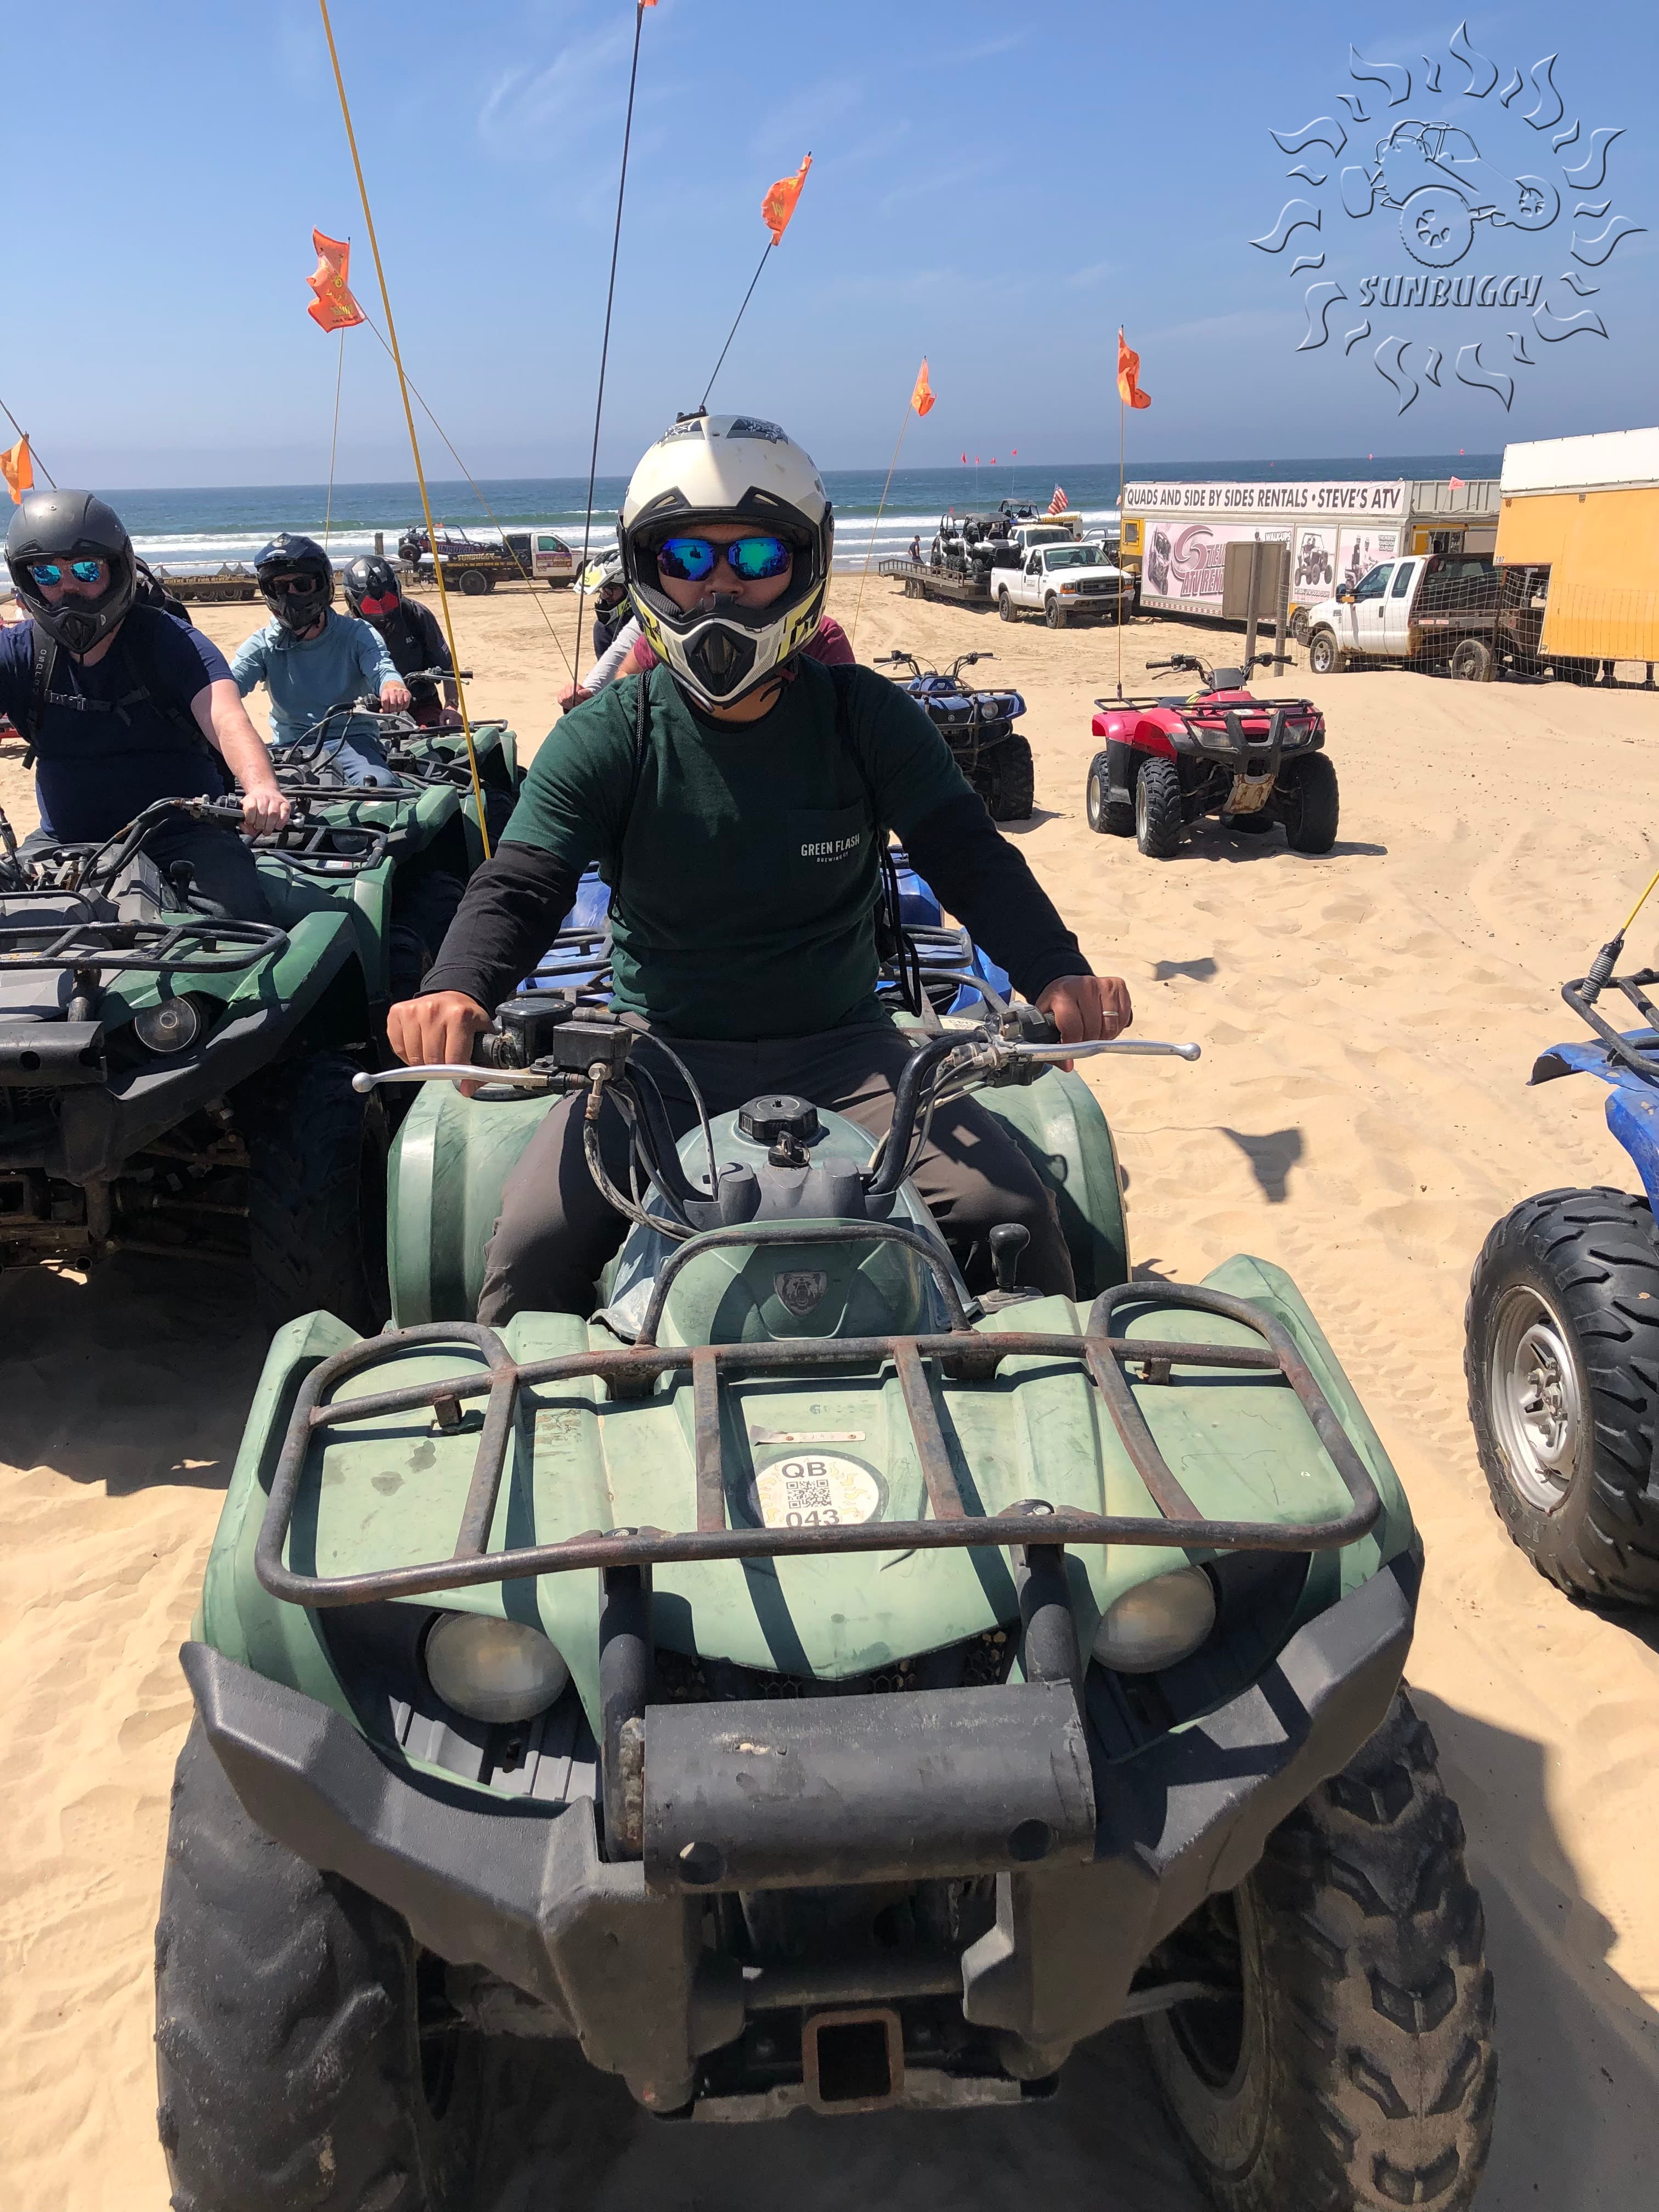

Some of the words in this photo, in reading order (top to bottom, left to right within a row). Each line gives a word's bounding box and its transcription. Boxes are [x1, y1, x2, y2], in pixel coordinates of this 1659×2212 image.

[1127, 488, 1158, 506] QUADS
[1160, 489, 1181, 506] AND
[1184, 489, 1206, 506] SIDE
[1209, 489, 1222, 506] BY
[1224, 489, 1254, 507] SIDES
[1257, 488, 1308, 507] RENTALS
[1317, 488, 1368, 509] STEVE'S
[1370, 488, 1401, 509] ATV
[1181, 570, 1202, 596] ATV
[801, 841, 833, 856] GREEN
[836, 833, 860, 853] FLASH
[781, 1462, 827, 1479] QB
[786, 1509, 840, 1527] 043
